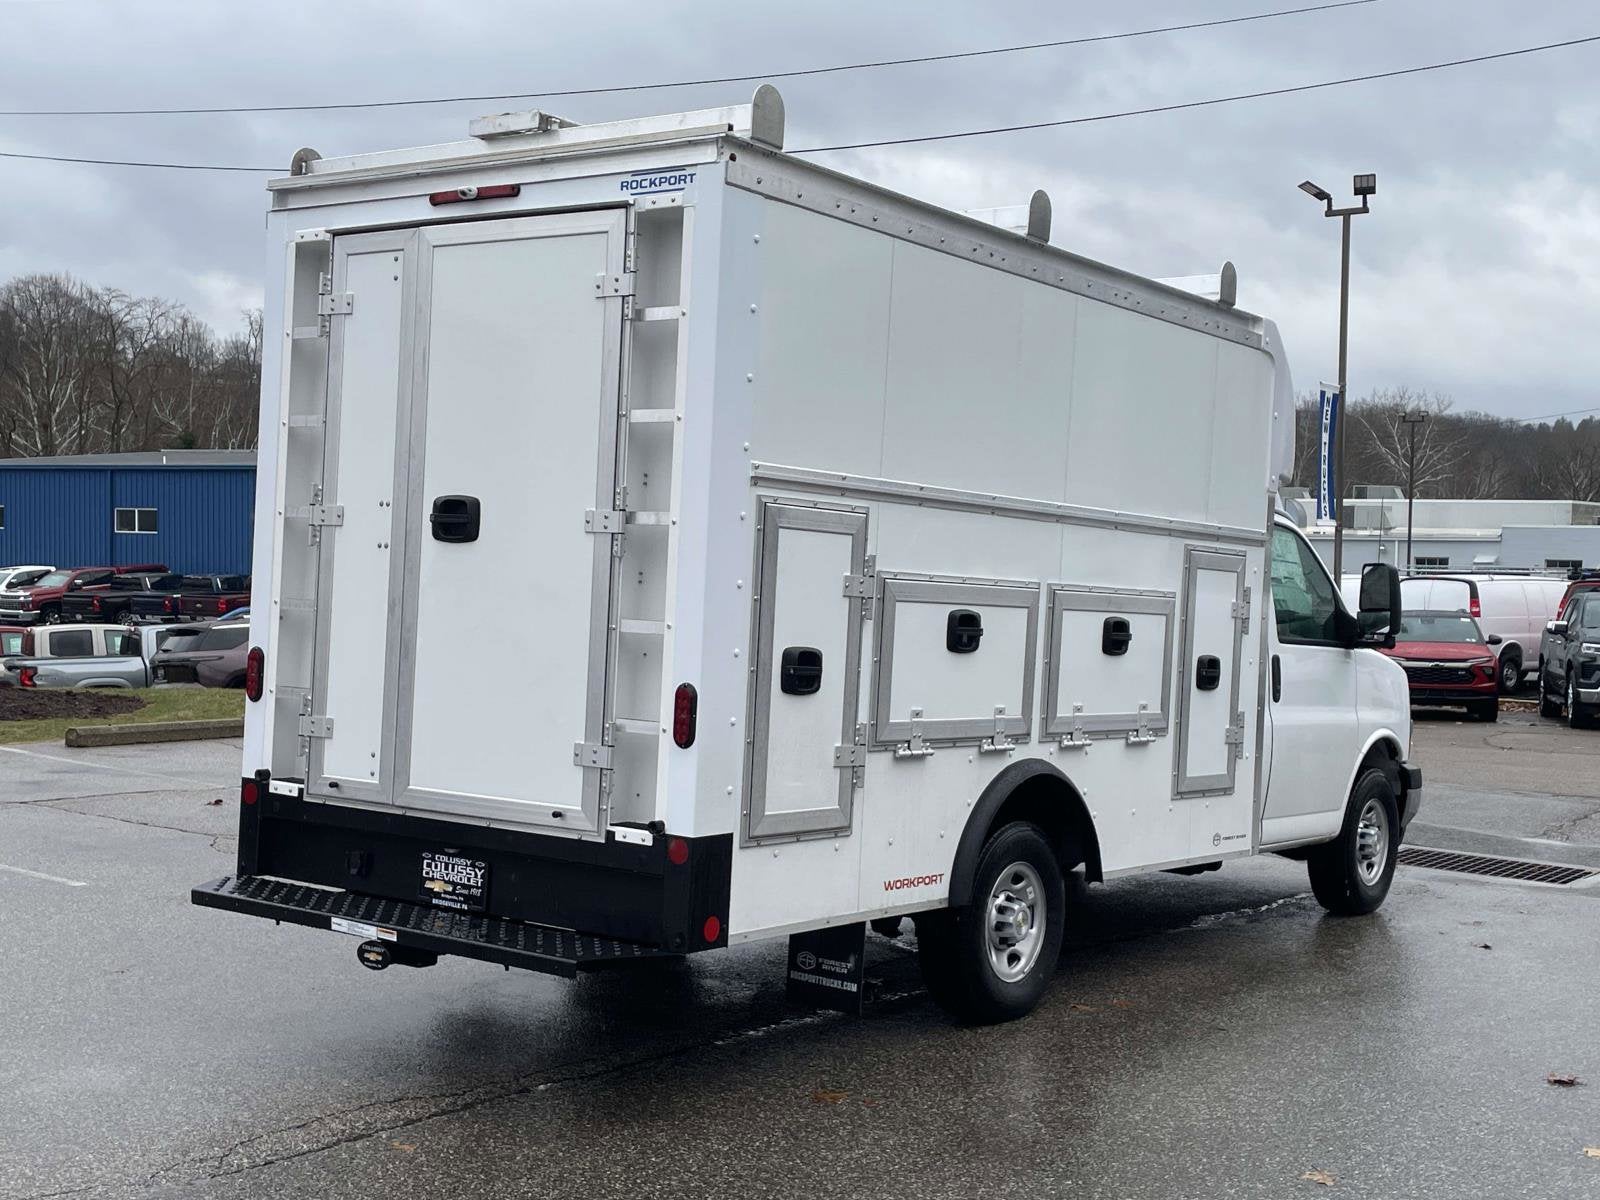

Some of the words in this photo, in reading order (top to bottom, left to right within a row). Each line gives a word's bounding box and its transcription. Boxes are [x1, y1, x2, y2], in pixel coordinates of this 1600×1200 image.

[620, 173, 696, 191] ROCKPORT
[435, 854, 472, 866] COLUSSY
[422, 869, 483, 887] CHEVROLET
[423, 860, 484, 879] COLUSSY
[883, 873, 944, 891] WORKPORT
[822, 964, 848, 974] RIVER
